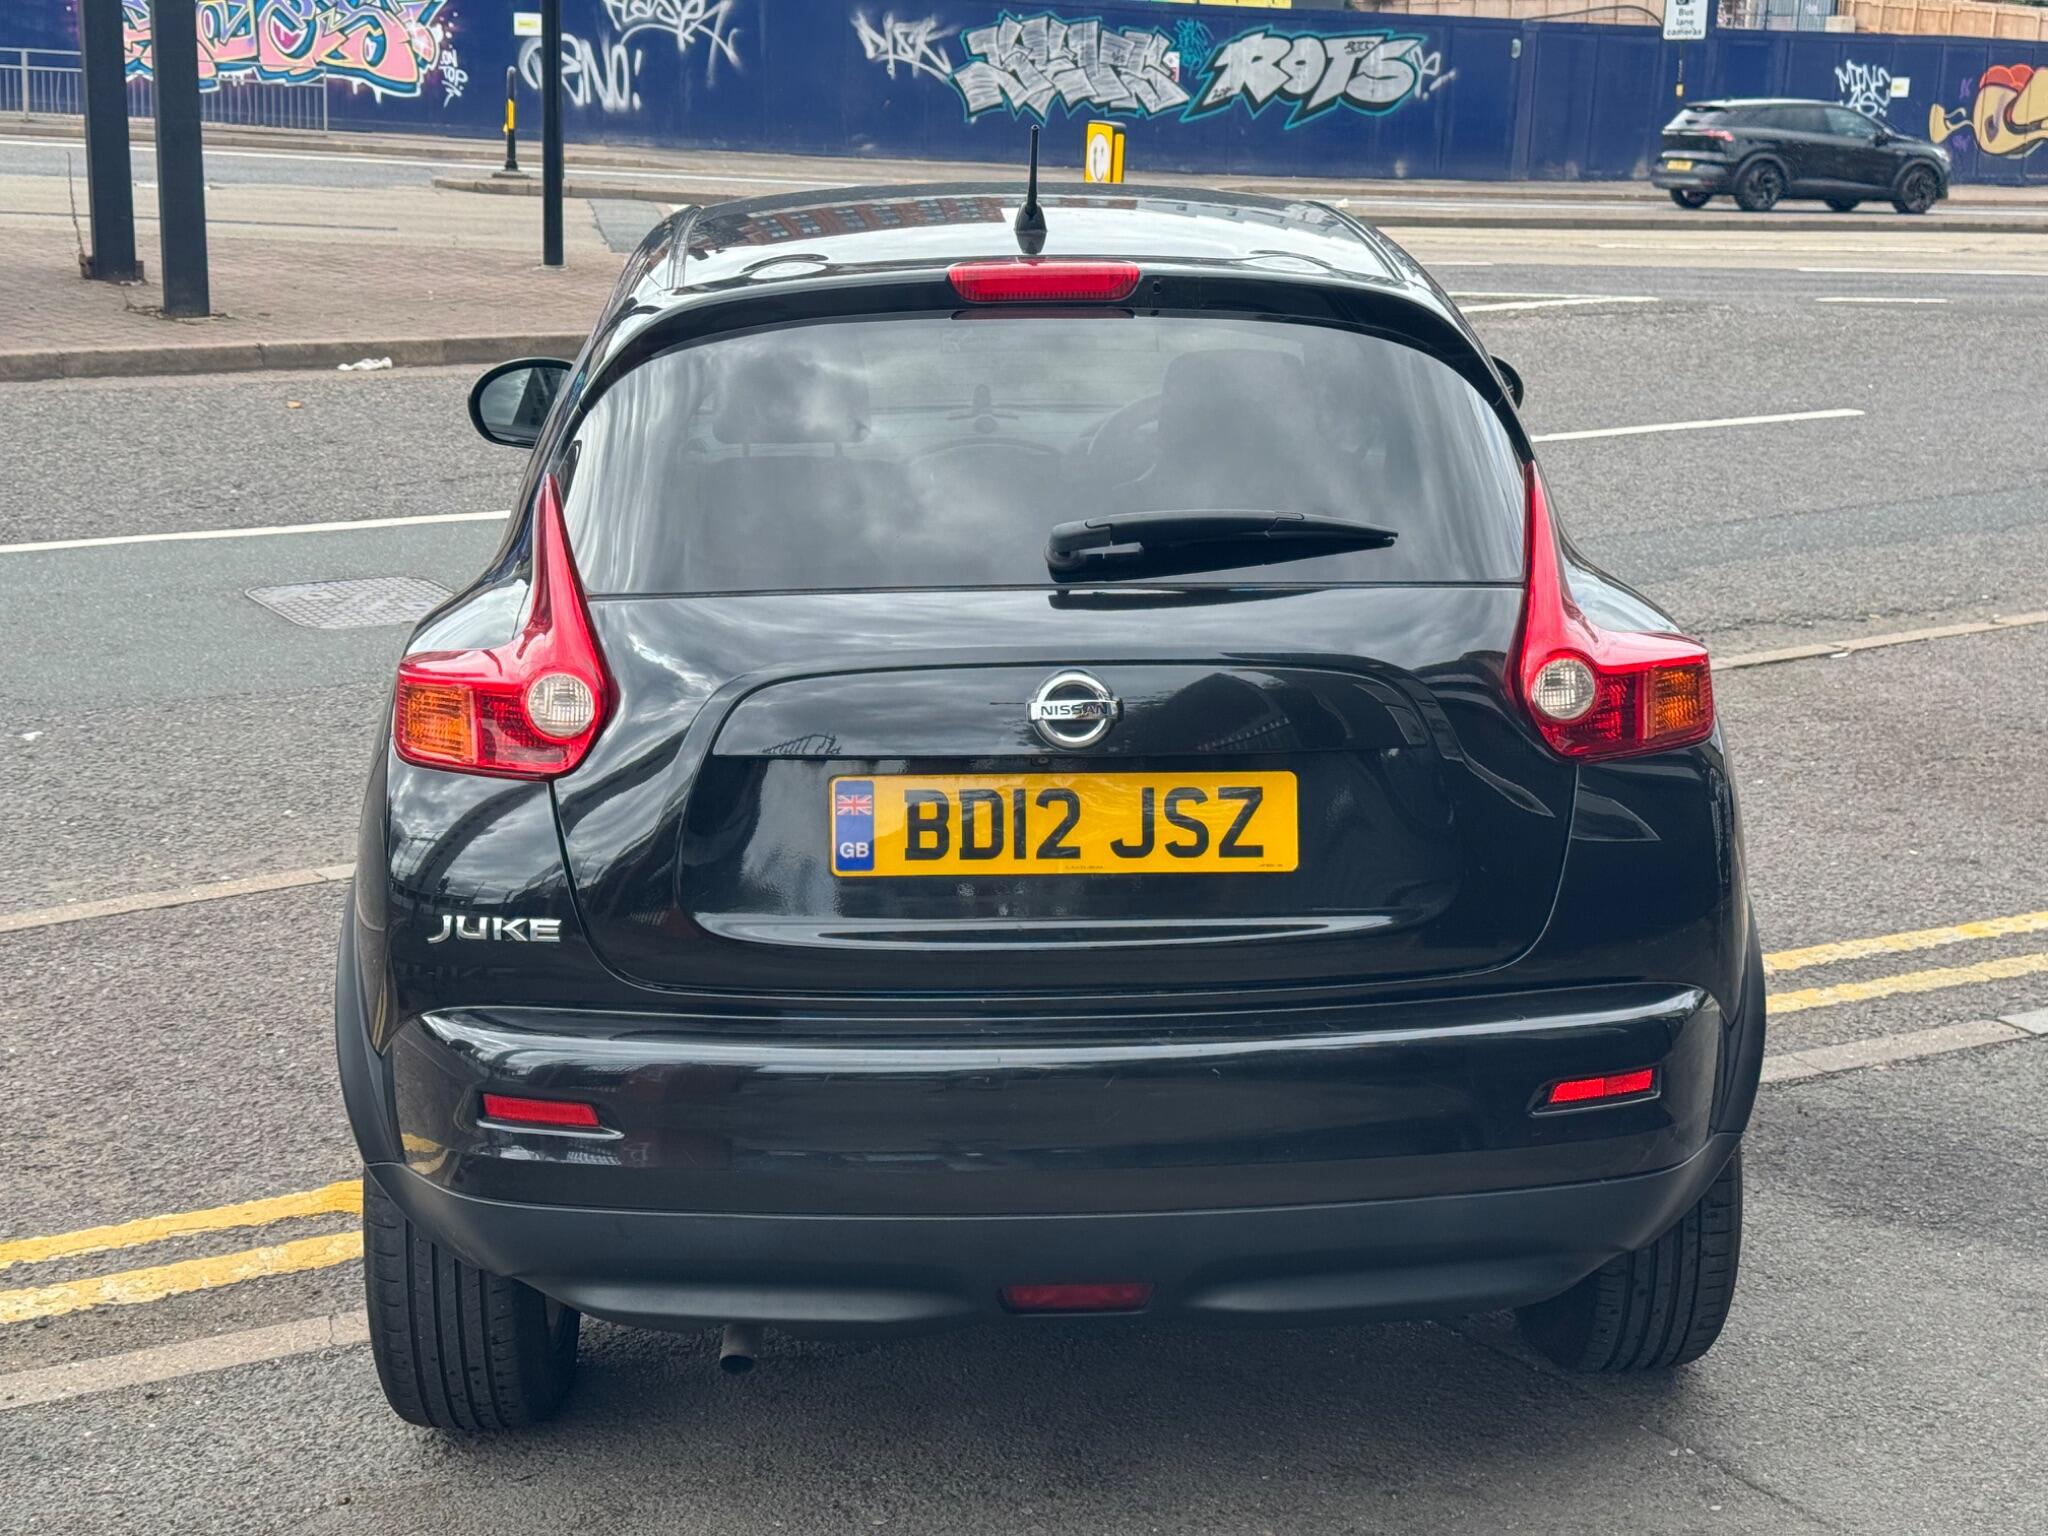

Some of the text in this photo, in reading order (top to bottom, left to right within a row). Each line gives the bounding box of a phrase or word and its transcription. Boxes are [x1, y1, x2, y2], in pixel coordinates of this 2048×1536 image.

[1678, 8, 1695, 16] Bus
[1676, 18, 1695, 26] lane
[1667, 28, 1703, 36] cameras
[1041, 704, 1108, 716] NISSAN
[904, 786, 1264, 861] BD12 JSZ
[839, 841, 870, 859] GB
[427, 914, 562, 944] JUKE
